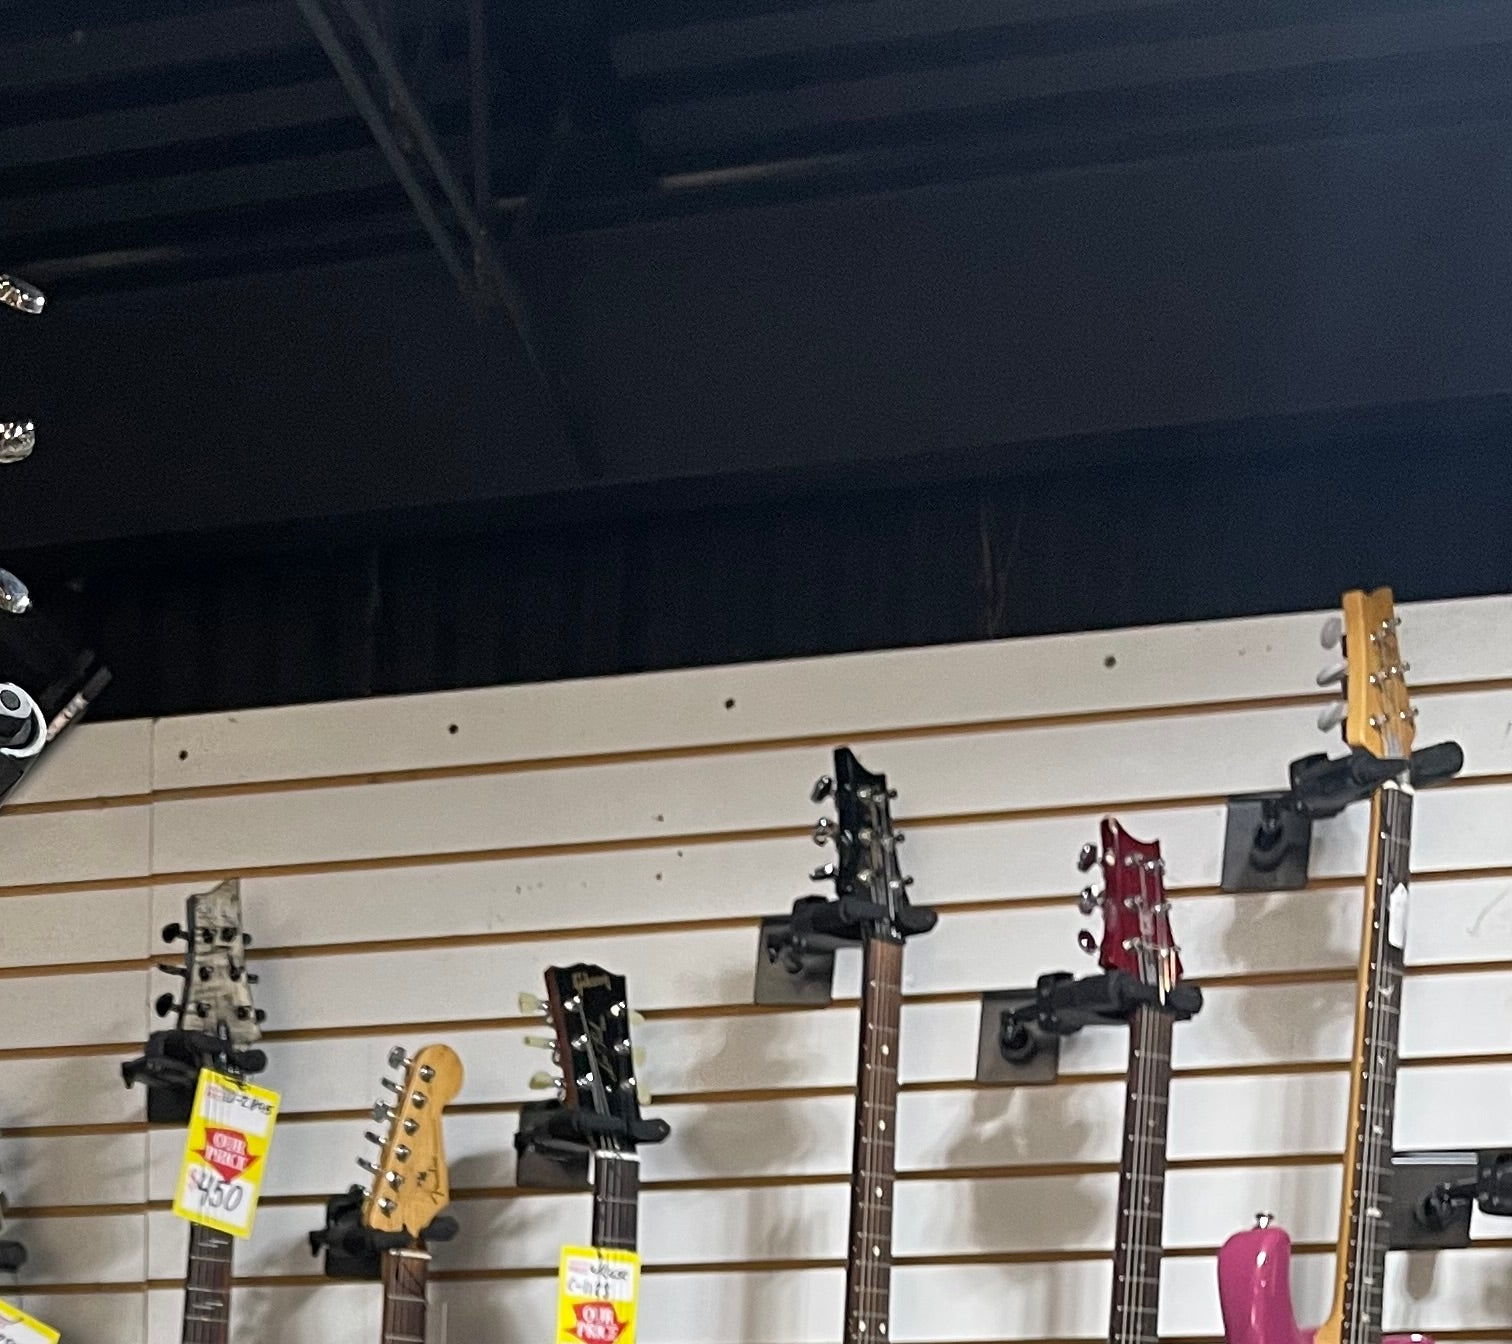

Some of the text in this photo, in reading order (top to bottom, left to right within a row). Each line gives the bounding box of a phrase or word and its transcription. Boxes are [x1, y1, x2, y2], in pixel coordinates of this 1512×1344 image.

[212, 1131, 246, 1154] OUR
[204, 1145, 249, 1171] PRICE
[581, 1304, 615, 1325] OUR
[576, 1320, 620, 1343] PRICE
